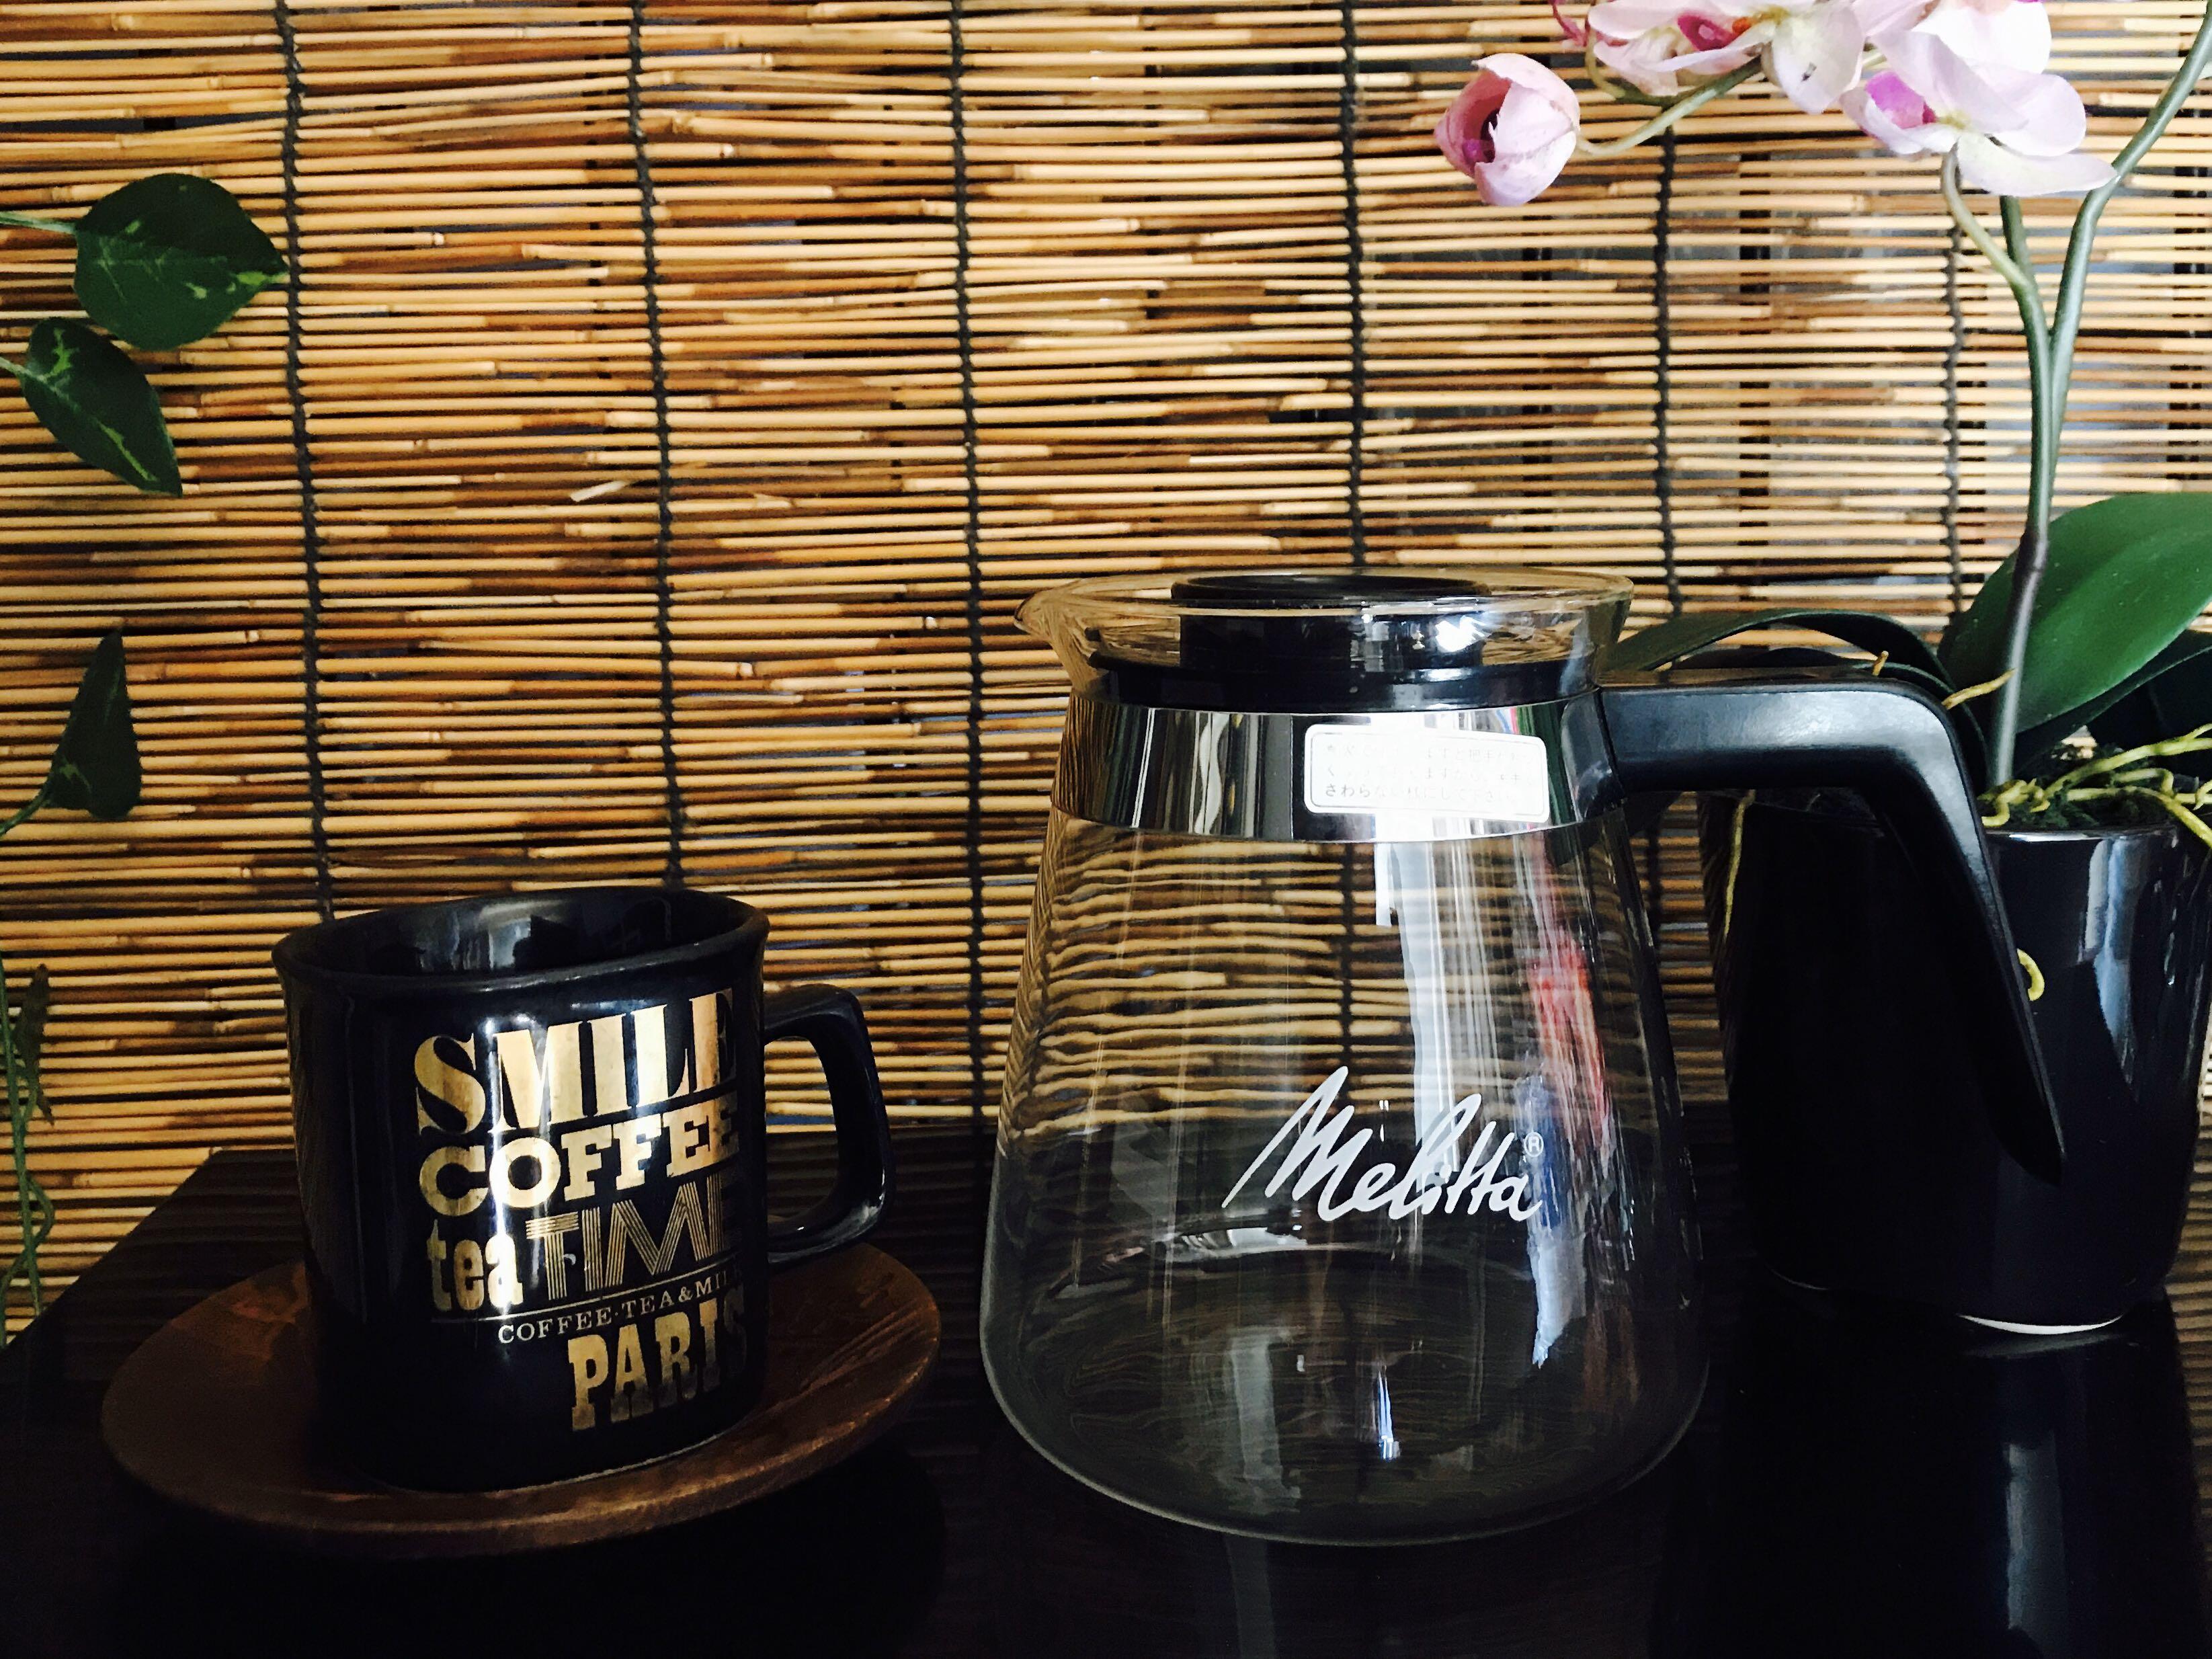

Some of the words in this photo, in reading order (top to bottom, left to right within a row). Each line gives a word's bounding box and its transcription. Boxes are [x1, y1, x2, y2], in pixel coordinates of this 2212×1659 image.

[413, 987, 737, 1136] SMILE
[419, 1090, 739, 1216] COFFEE
[427, 1219, 524, 1311] tea
[567, 1284, 748, 1432] PARIS
